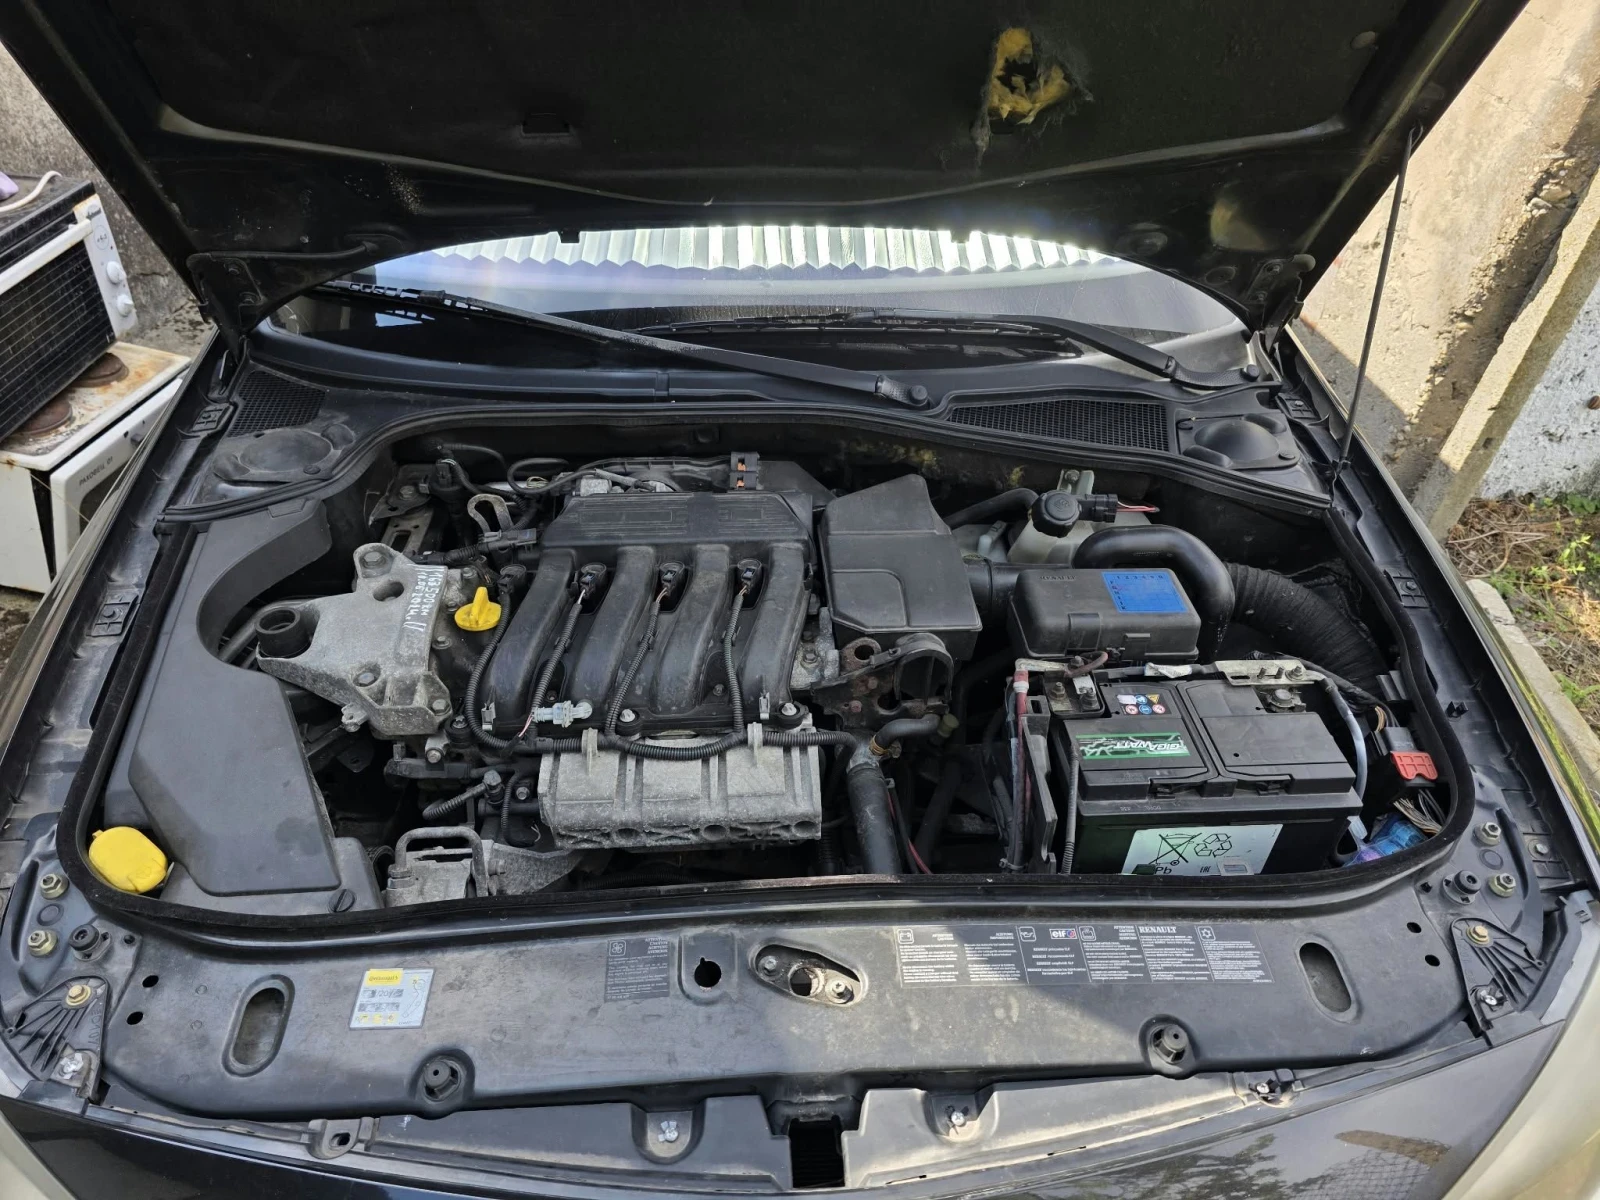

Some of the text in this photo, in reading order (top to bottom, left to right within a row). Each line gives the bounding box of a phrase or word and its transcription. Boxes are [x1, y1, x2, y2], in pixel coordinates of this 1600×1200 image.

[1113, 739, 1181, 751] GIGAWATT
[1154, 866, 1173, 875] Pb
[1051, 929, 1067, 938] elf
[1138, 925, 1177, 934] RENAULT
